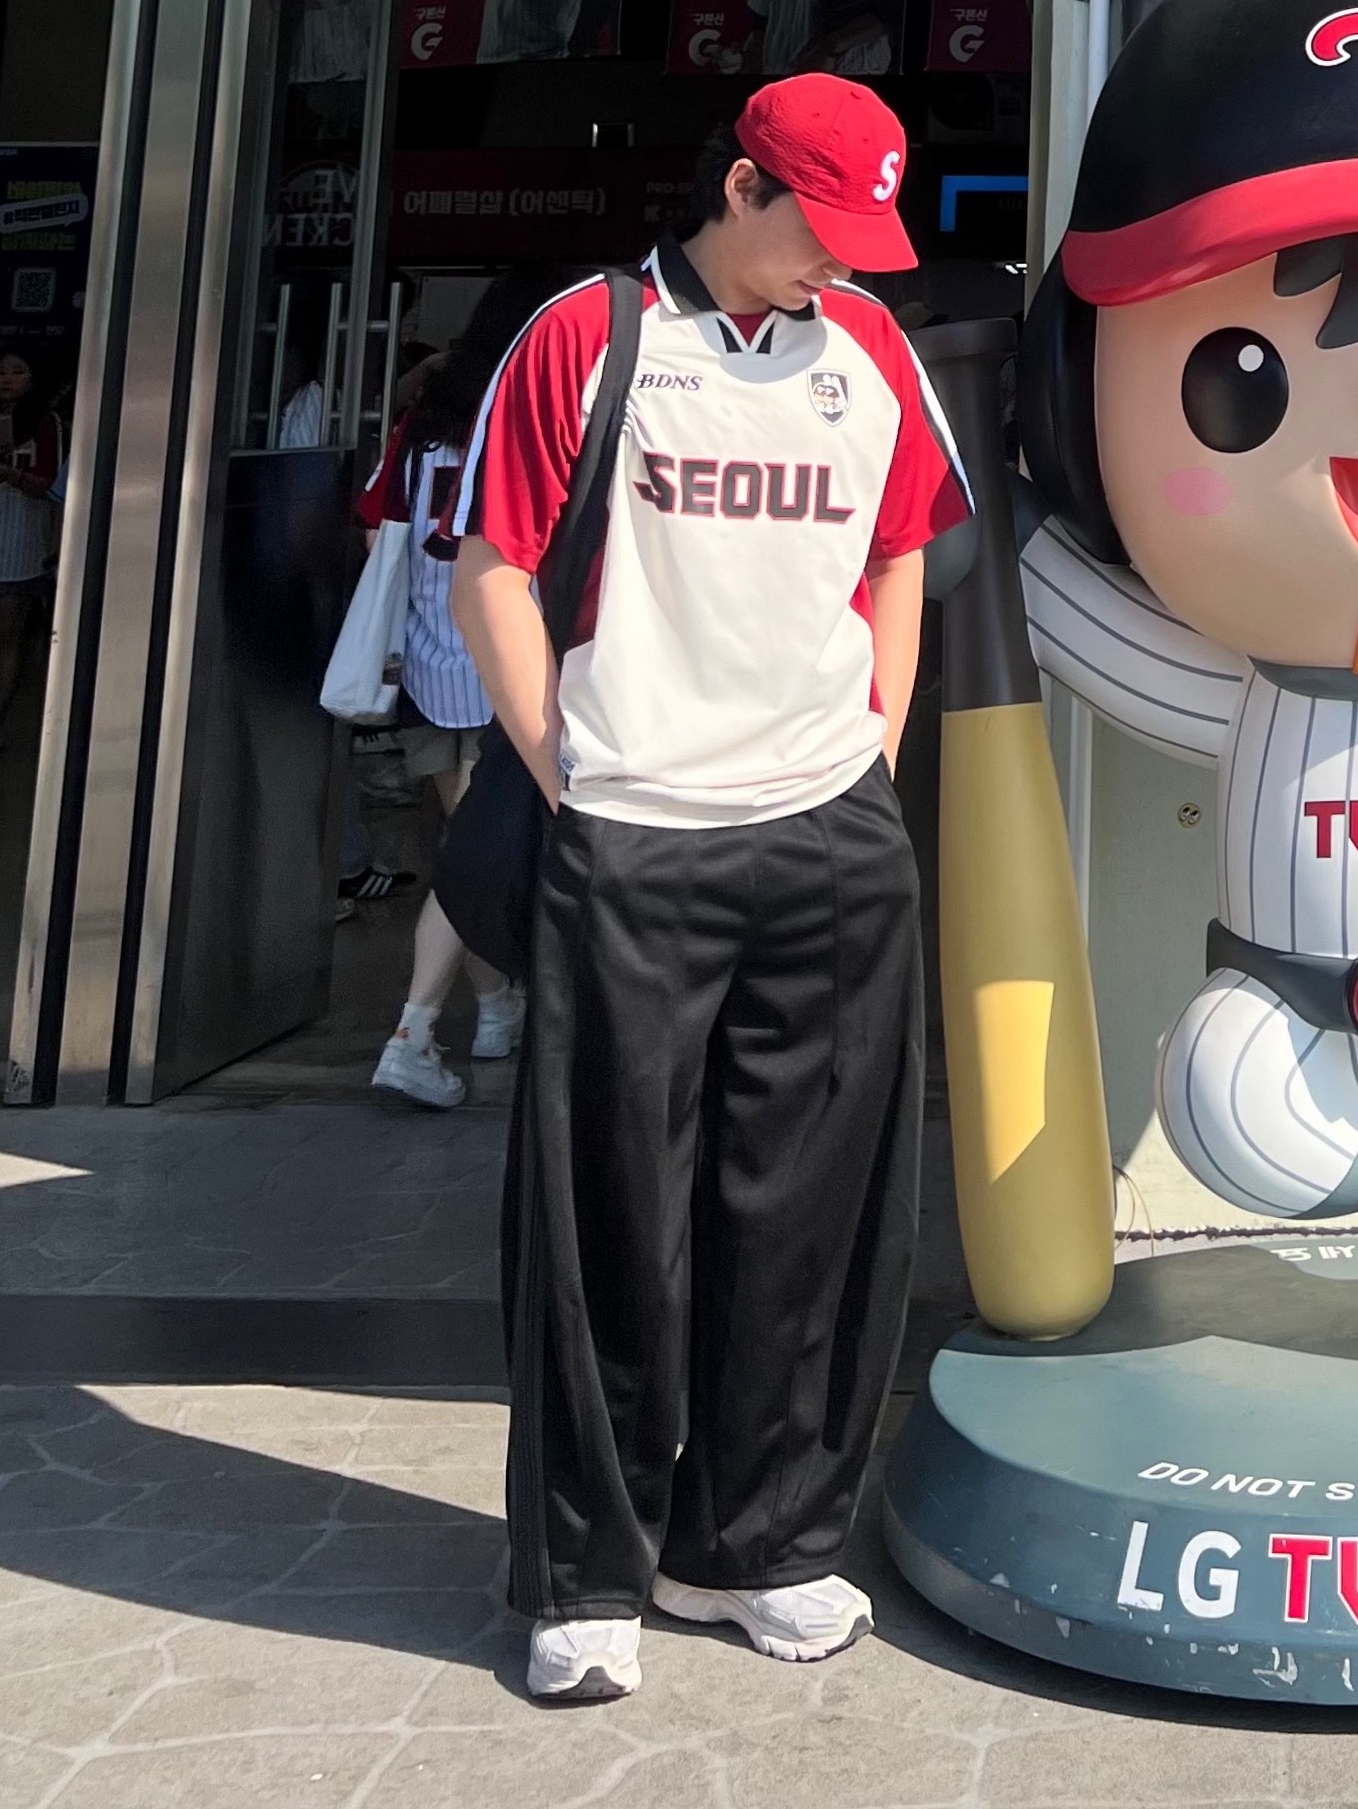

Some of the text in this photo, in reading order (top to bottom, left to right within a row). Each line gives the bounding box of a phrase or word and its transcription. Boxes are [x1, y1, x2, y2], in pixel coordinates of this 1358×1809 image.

[872, 150, 901, 202] S
[636, 371, 704, 392] BDNS
[632, 449, 857, 525] SEOUL
[1137, 1461, 1210, 1487] DO
[1211, 1473, 1316, 1499] NOT
[1117, 1521, 1243, 1619] LG
